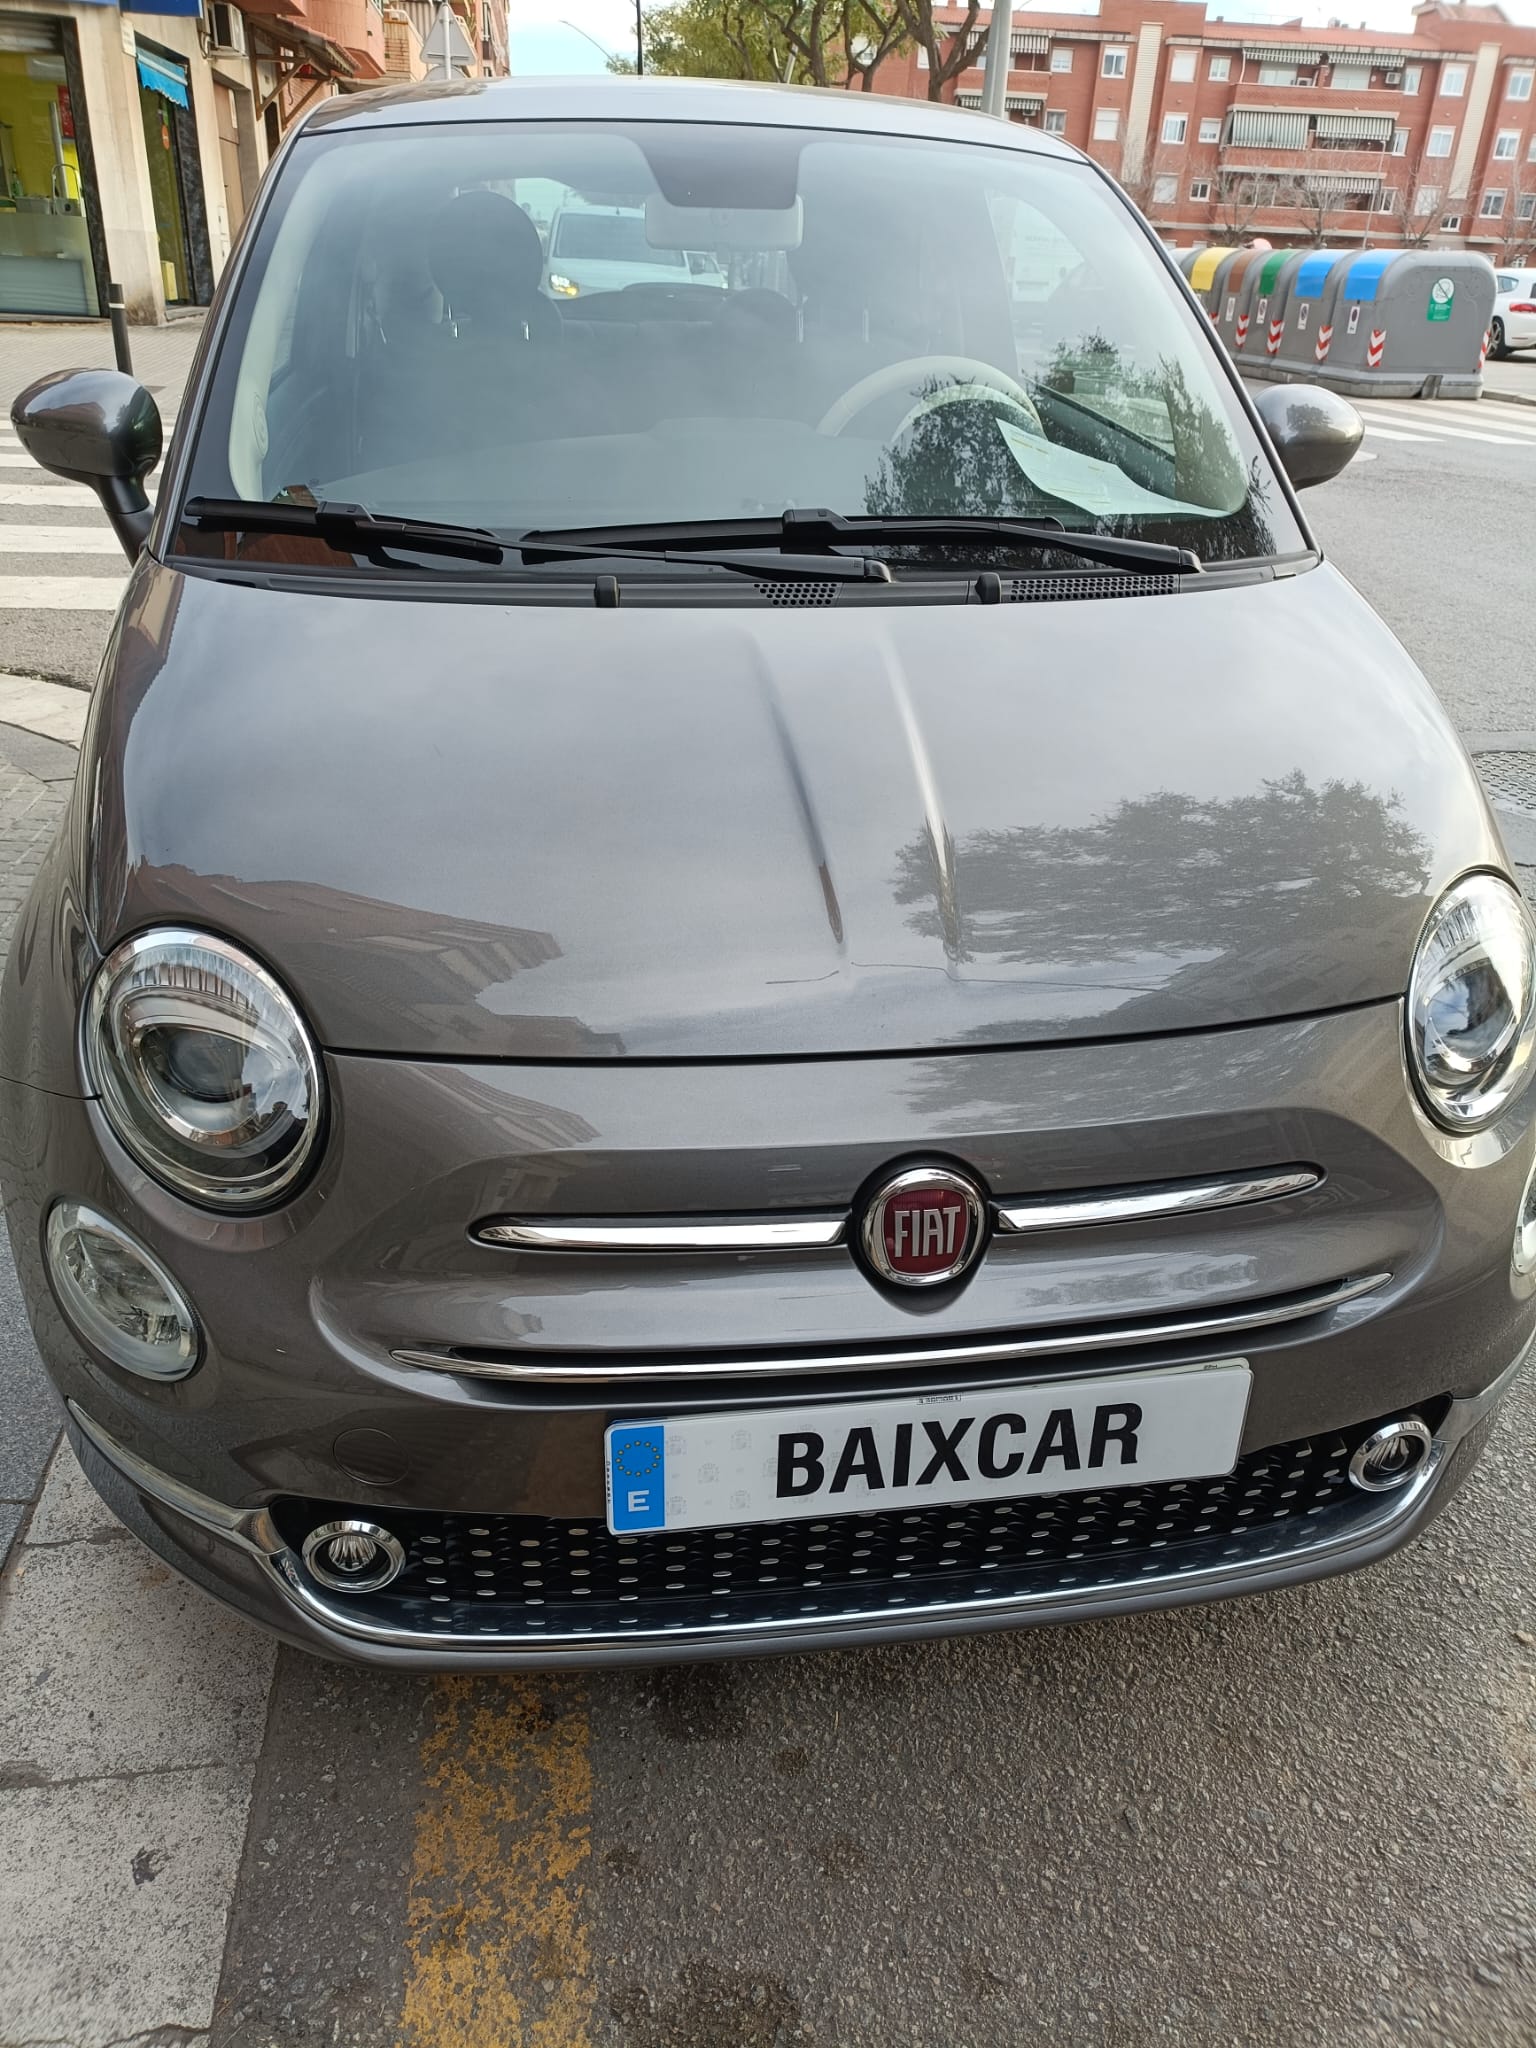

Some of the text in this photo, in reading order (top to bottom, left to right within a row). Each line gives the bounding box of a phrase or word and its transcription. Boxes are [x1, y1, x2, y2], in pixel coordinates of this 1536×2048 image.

[894, 1206, 961, 1258] FIAT
[776, 1402, 1143, 1498] BAIXCAR
[627, 1489, 650, 1513] E
